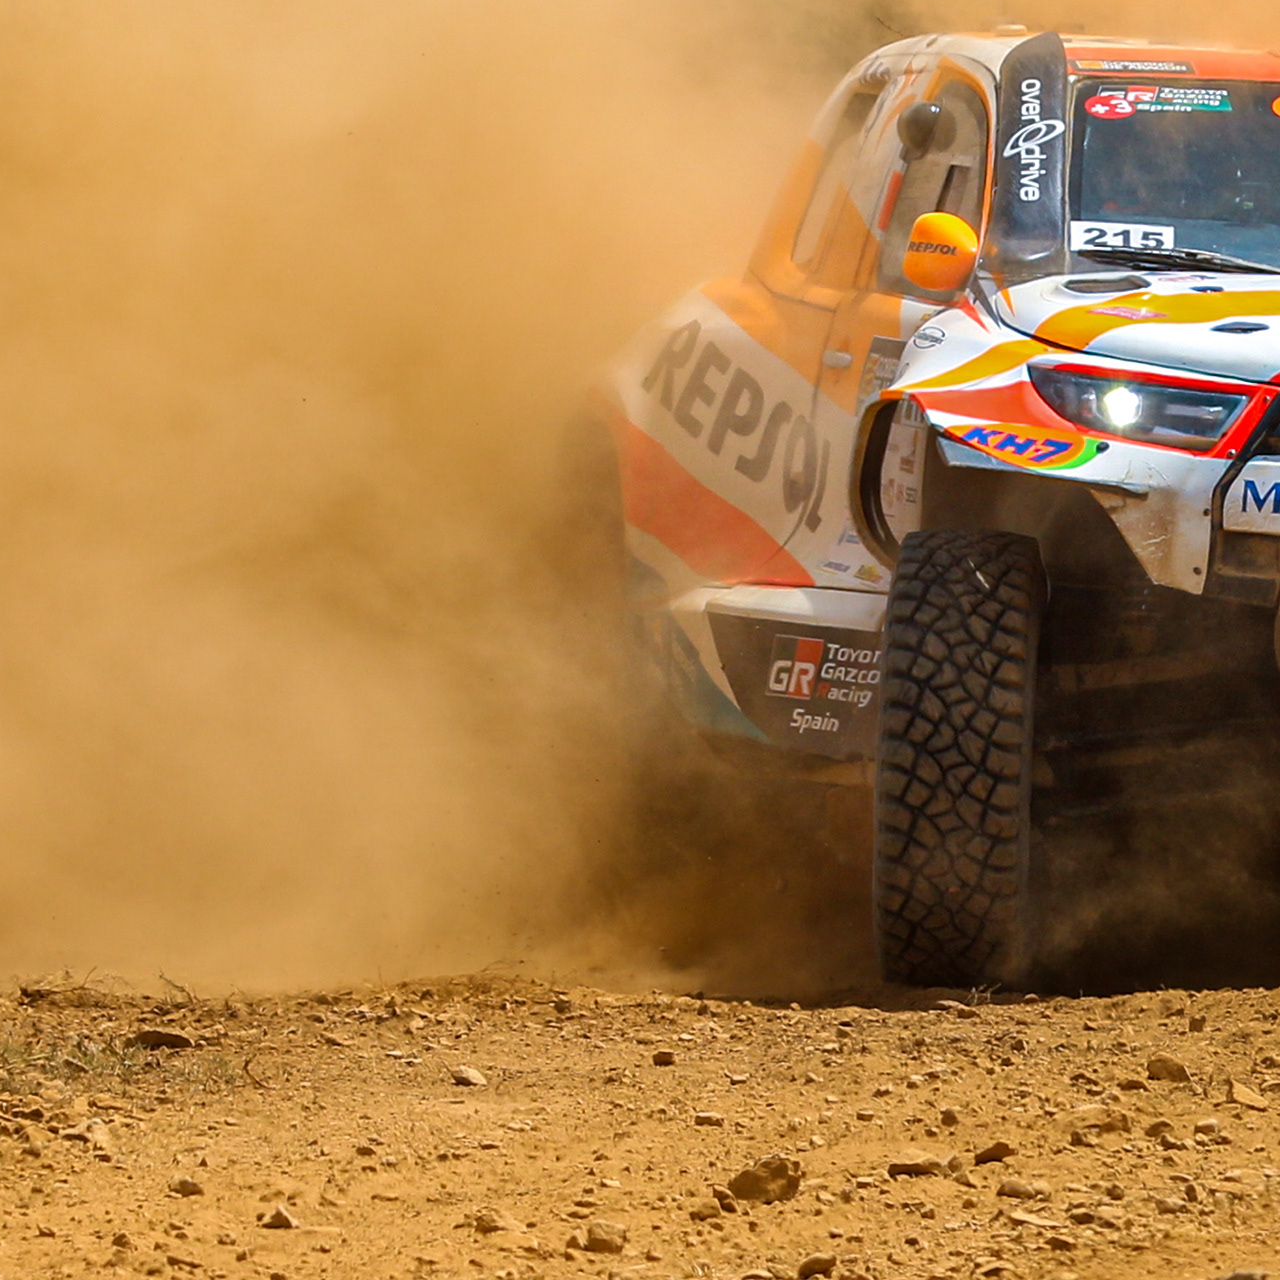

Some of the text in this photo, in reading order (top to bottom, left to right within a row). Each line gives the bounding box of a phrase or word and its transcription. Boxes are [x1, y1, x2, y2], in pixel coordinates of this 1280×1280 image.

[1136, 101, 1193, 112] Spain
[908, 241, 958, 256] REPSOL
[1083, 227, 1165, 249] 215
[641, 318, 832, 534] REPSOL
[962, 426, 1074, 464] KH-7
[826, 643, 882, 664] TOYOT
[768, 659, 816, 696] GR
[789, 707, 840, 734] Spain
